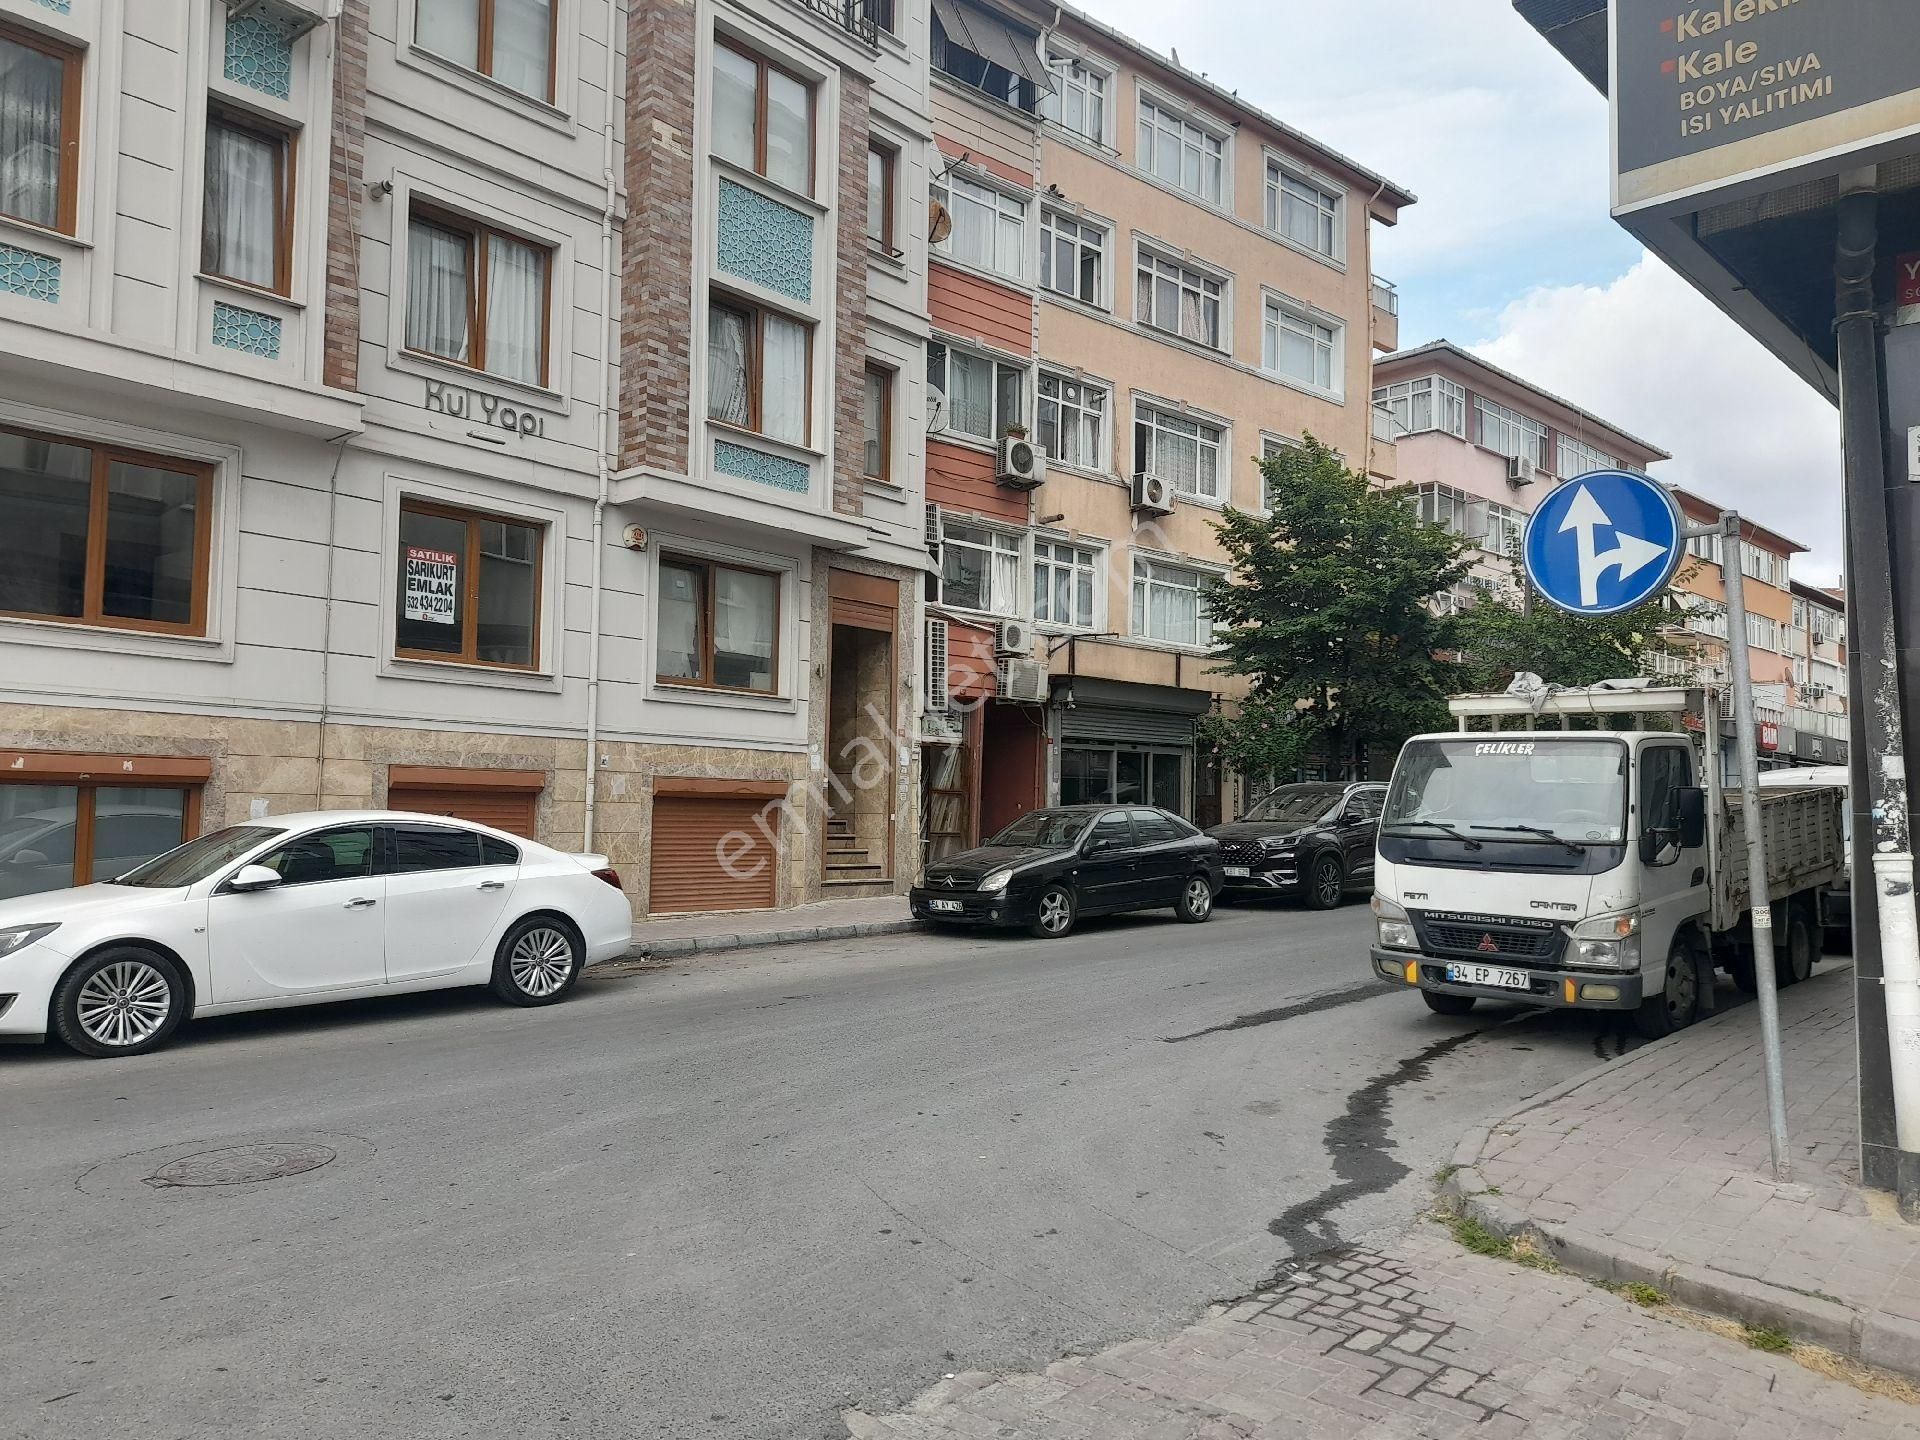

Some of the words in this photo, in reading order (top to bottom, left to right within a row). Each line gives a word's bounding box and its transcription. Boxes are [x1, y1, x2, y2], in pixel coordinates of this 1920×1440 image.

[1678, 40, 1758, 84] Kale
[1680, 52, 1822, 111] BOYA/SIVA
[1681, 112, 1712, 137] ISI
[1719, 75, 1833, 125] YALITIMI
[425, 380, 470, 419] Kul
[480, 393, 544, 439] Yapı
[409, 549, 454, 563] SATILIK
[407, 560, 455, 581] SARIKURT
[407, 577, 454, 596] EMLAK
[1475, 741, 1535, 757] ÇELİKLER
[1529, 900, 1578, 912] CANTER
[1424, 911, 1506, 925] MITSUBISHI
[1510, 919, 1554, 928] FUSO
[1454, 965, 1468, 980] 34
[1475, 967, 1490, 982] EP
[1497, 970, 1527, 987] 7267
